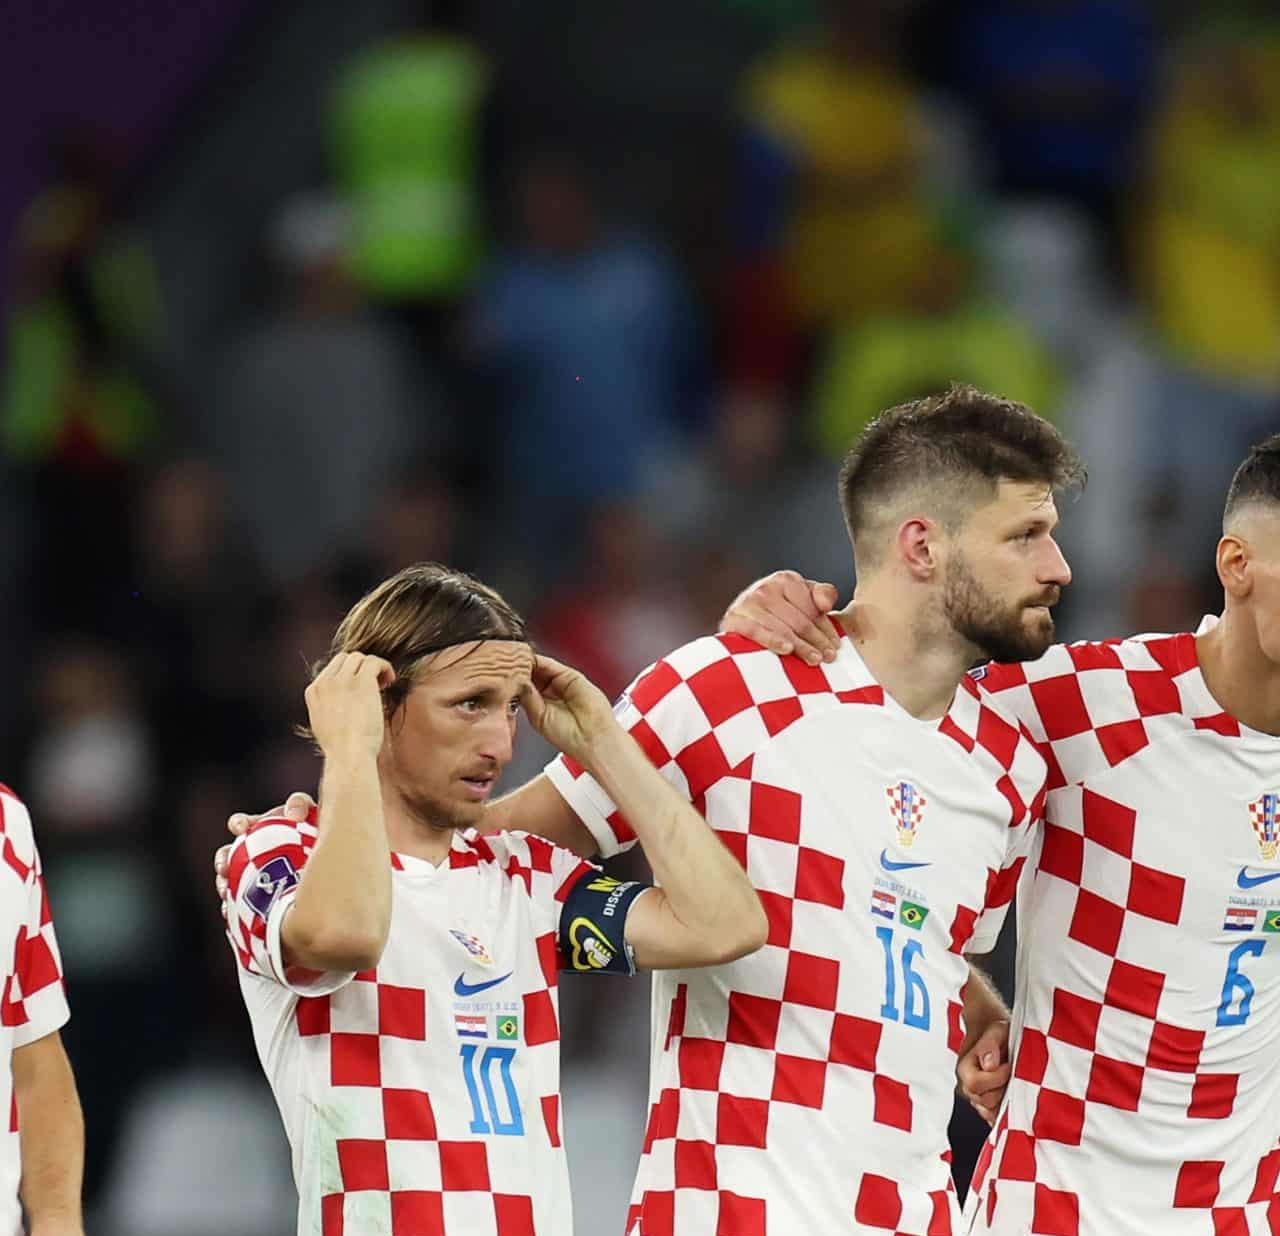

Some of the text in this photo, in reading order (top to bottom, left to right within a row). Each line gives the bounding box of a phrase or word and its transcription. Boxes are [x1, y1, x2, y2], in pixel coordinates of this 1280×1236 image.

[876, 927, 930, 1032] 16
[1216, 939, 1266, 1027] 6
[460, 1044, 525, 1136] 10
